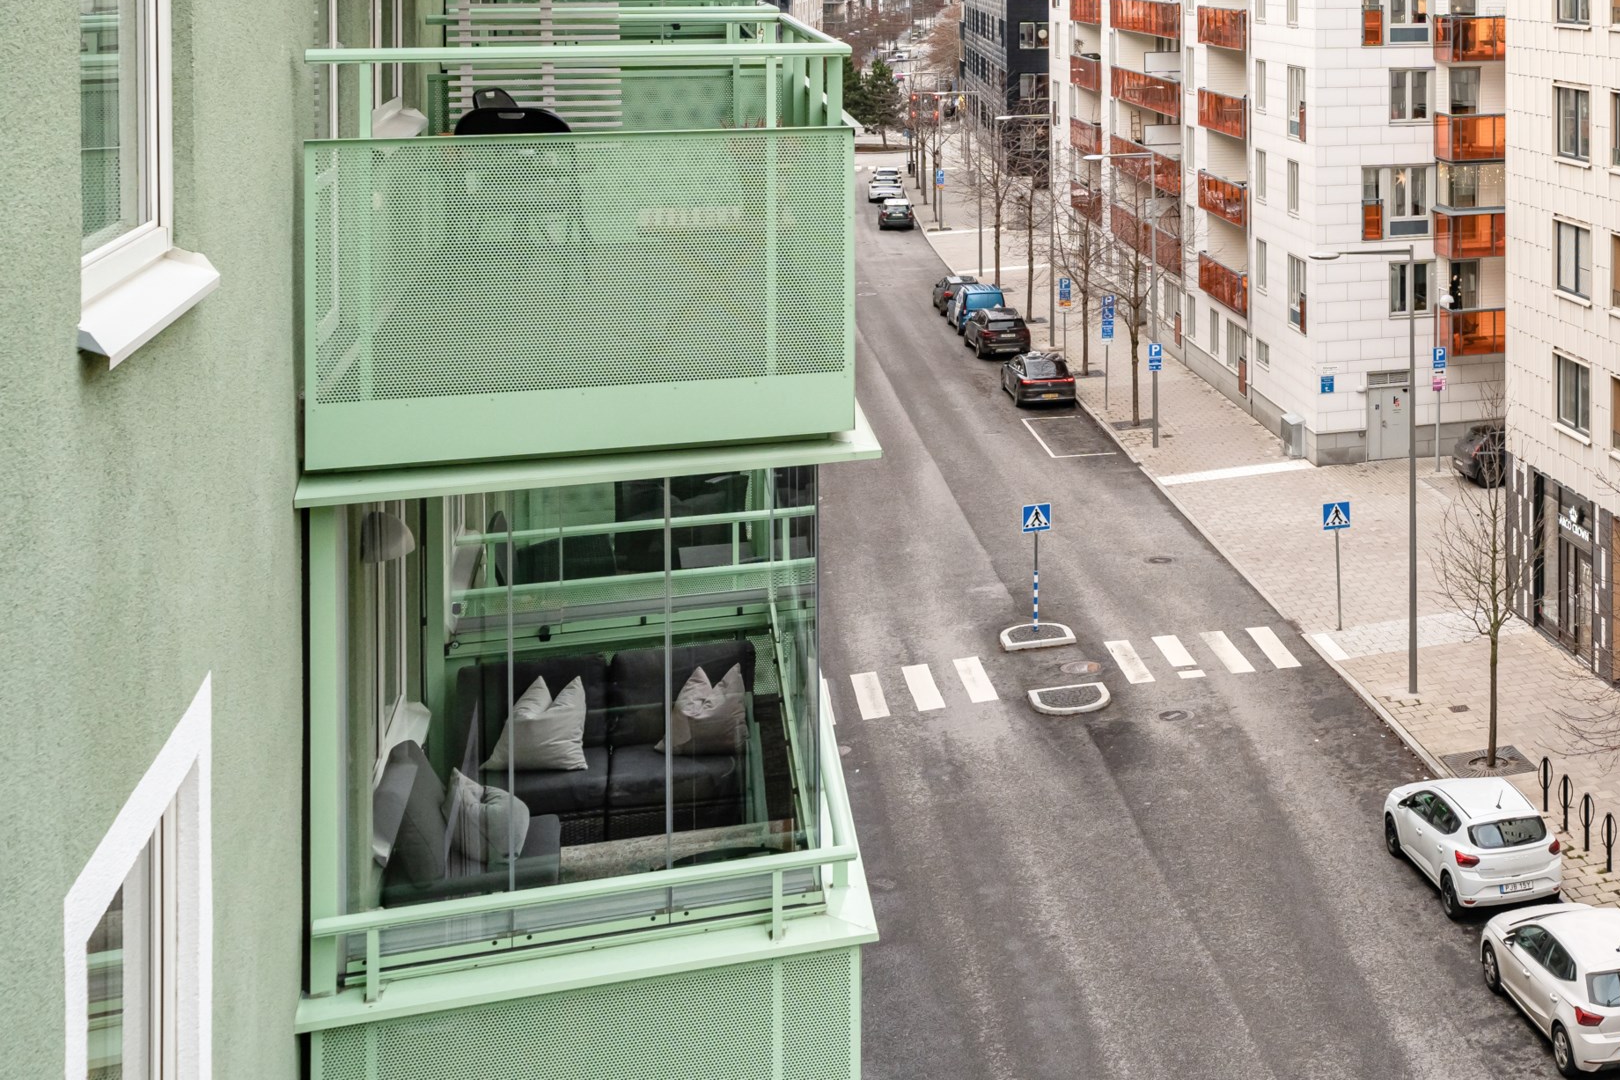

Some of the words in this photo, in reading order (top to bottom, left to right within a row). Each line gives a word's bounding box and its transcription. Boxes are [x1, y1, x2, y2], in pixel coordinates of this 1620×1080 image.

[1151, 345, 1160, 356] P
[1436, 348, 1444, 360] P
[1572, 523, 1590, 542] CROWN
